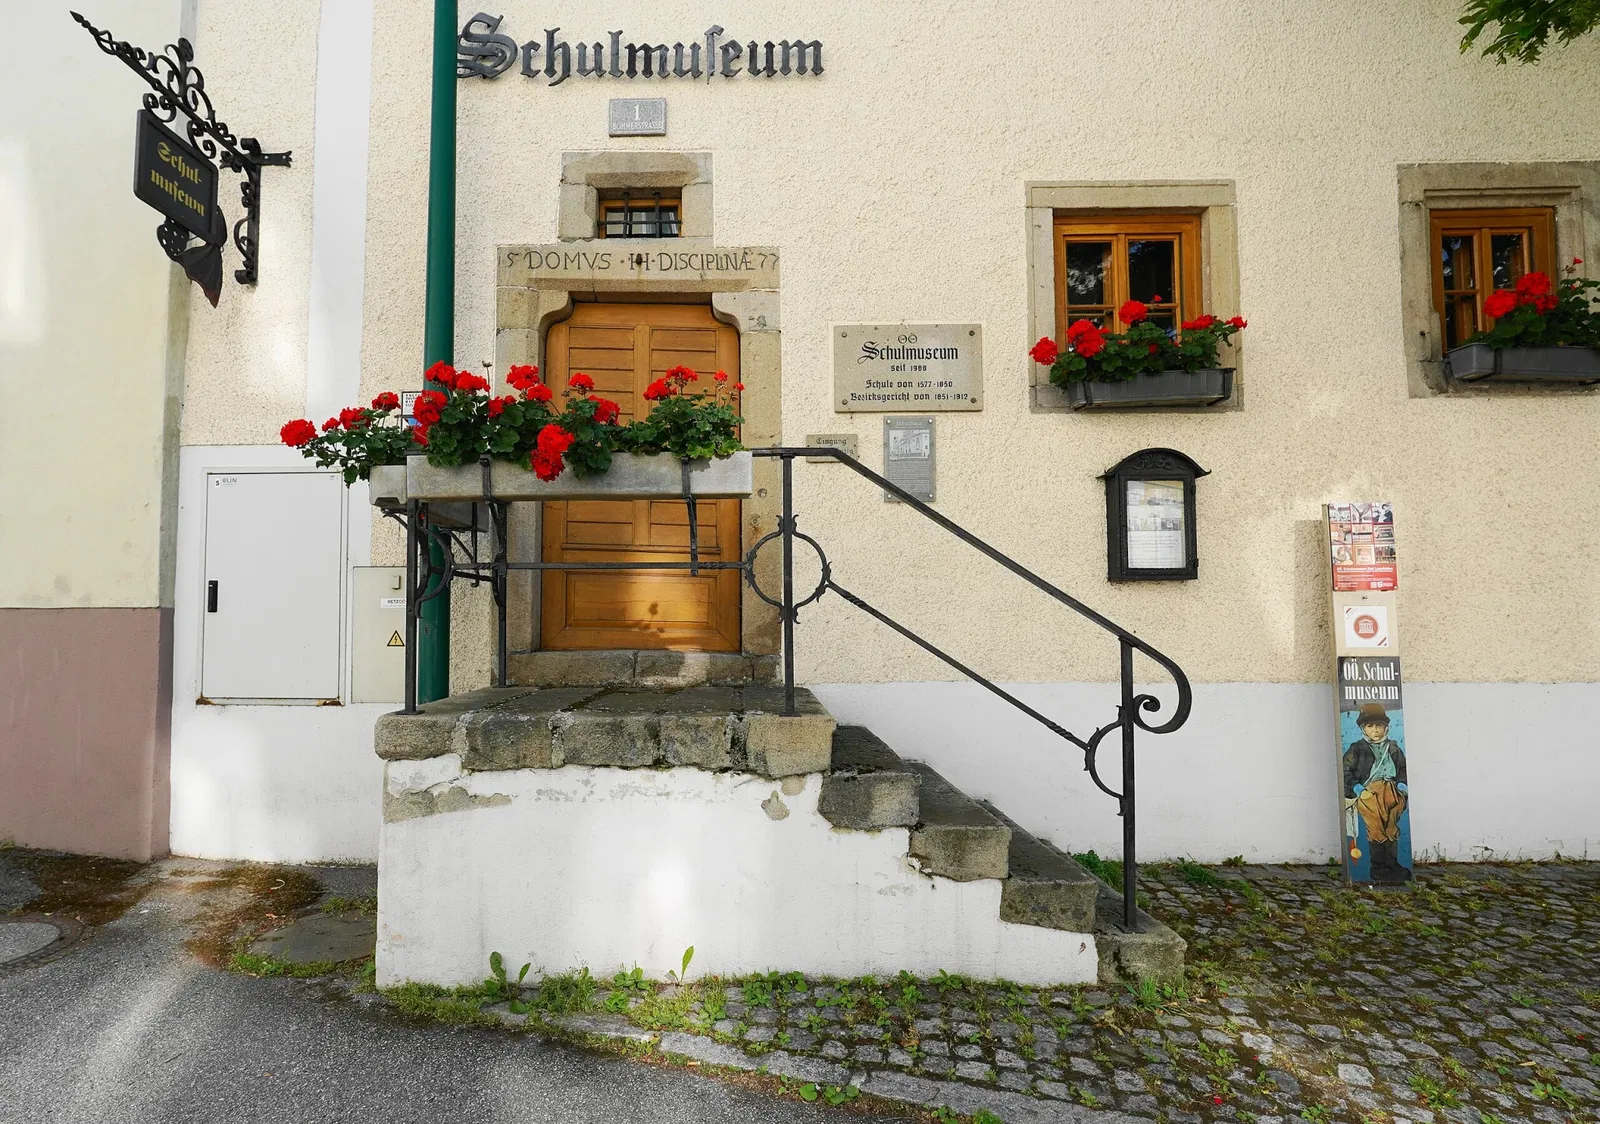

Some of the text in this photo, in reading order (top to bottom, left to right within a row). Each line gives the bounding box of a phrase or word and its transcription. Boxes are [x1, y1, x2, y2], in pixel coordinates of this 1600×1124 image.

[634, 104, 640, 120] 1
[523, 251, 612, 271] DOMVS
[857, 341, 959, 364] Schulmuseum
[890, 364, 906, 372] seit
[865, 379, 894, 389] Schule
[850, 392, 910, 402] Bezirksgericht
[816, 437, 847, 446] Eingang
[1343, 658, 1399, 681] OÖ. Schul-
[1344, 685, 1399, 700] museum
